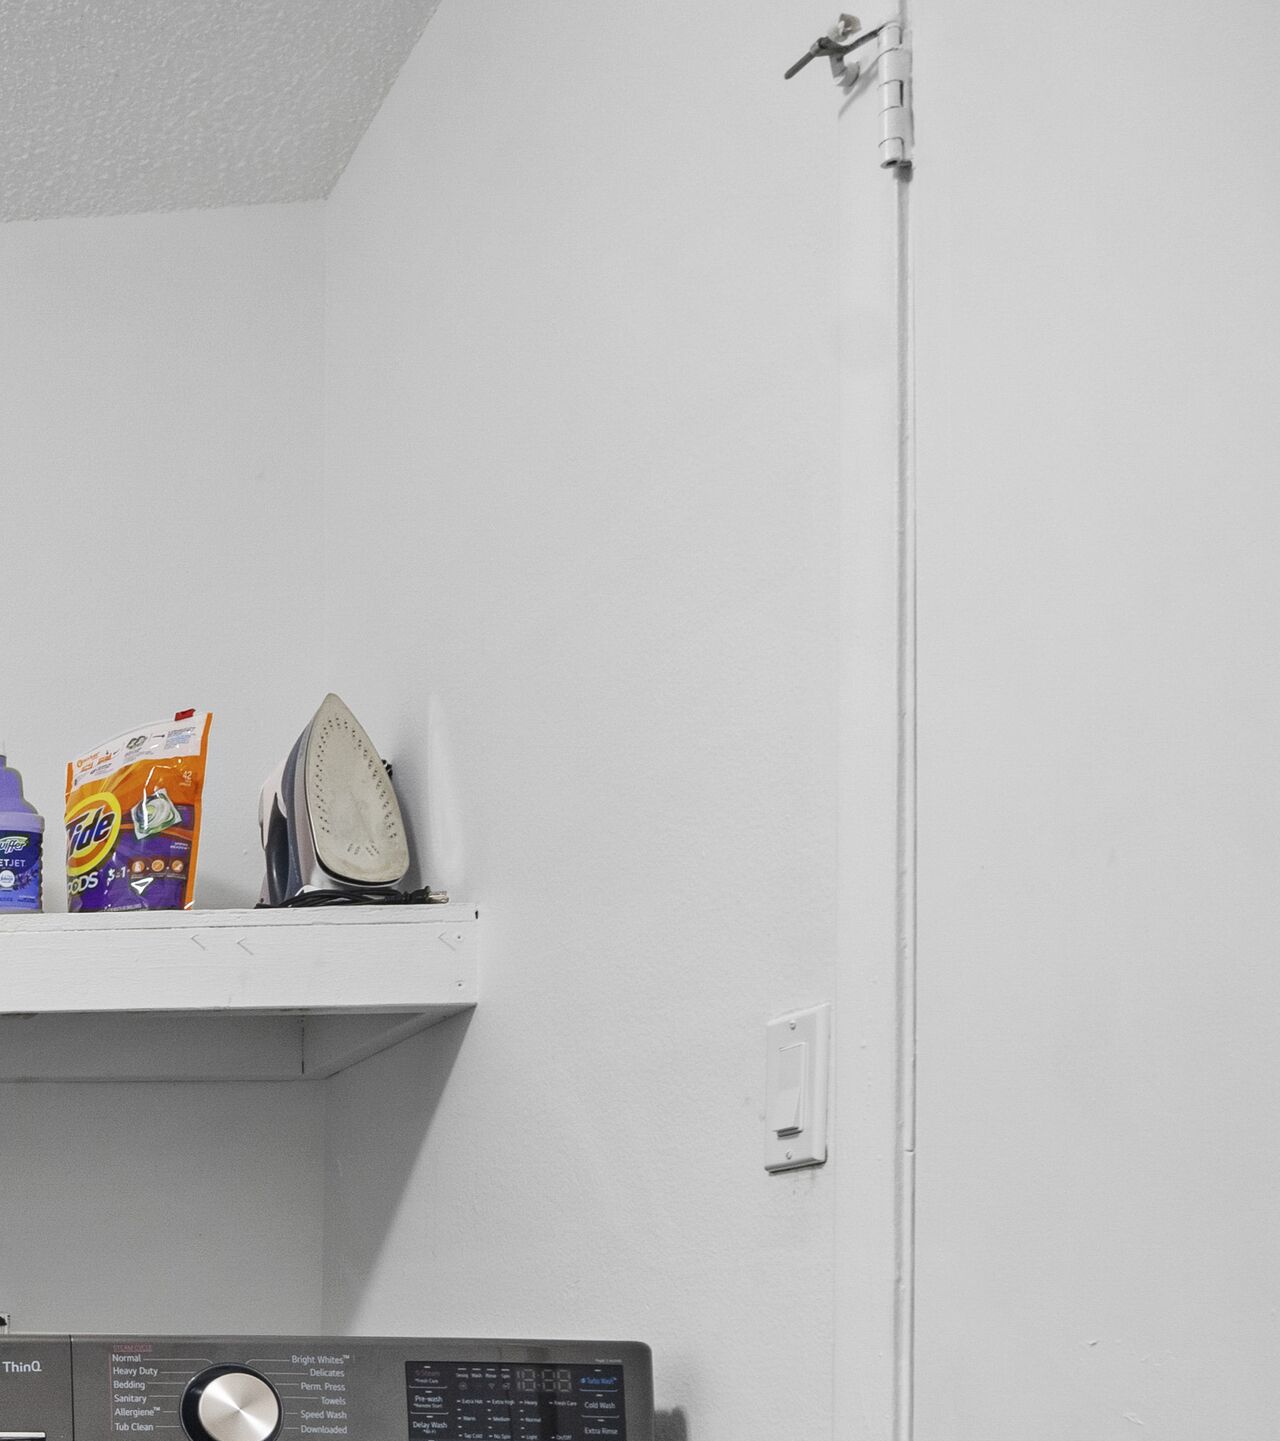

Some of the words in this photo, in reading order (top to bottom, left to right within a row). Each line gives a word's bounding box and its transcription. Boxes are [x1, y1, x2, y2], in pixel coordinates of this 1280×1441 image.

[66, 804, 116, 858] Tide
[112, 1354, 141, 1362] Normal
[292, 1355, 316, 1366] Bright
[2, 1360, 42, 1373] ThinQ
[112, 1367, 137, 1377] Heavy
[139, 1367, 158, 1377] Duty
[310, 1368, 345, 1377] Delicates
[113, 1380, 145, 1391] Bedding
[301, 1382, 322, 1391] Perm.
[324, 1382, 346, 1391] Press
[114, 1394, 147, 1404] Sanitary
[321, 1396, 347, 1406] Towels
[584, 1401, 598, 1409] Cold
[301, 1410, 325, 1420] Speed
[326, 1410, 348, 1419] Wash
[114, 1422, 129, 1431] Tub
[131, 1422, 154, 1431] Clean
[301, 1425, 348, 1434] Downloaded
[412, 1421, 430, 1429] Delay
[431, 1421, 448, 1429] Wash
